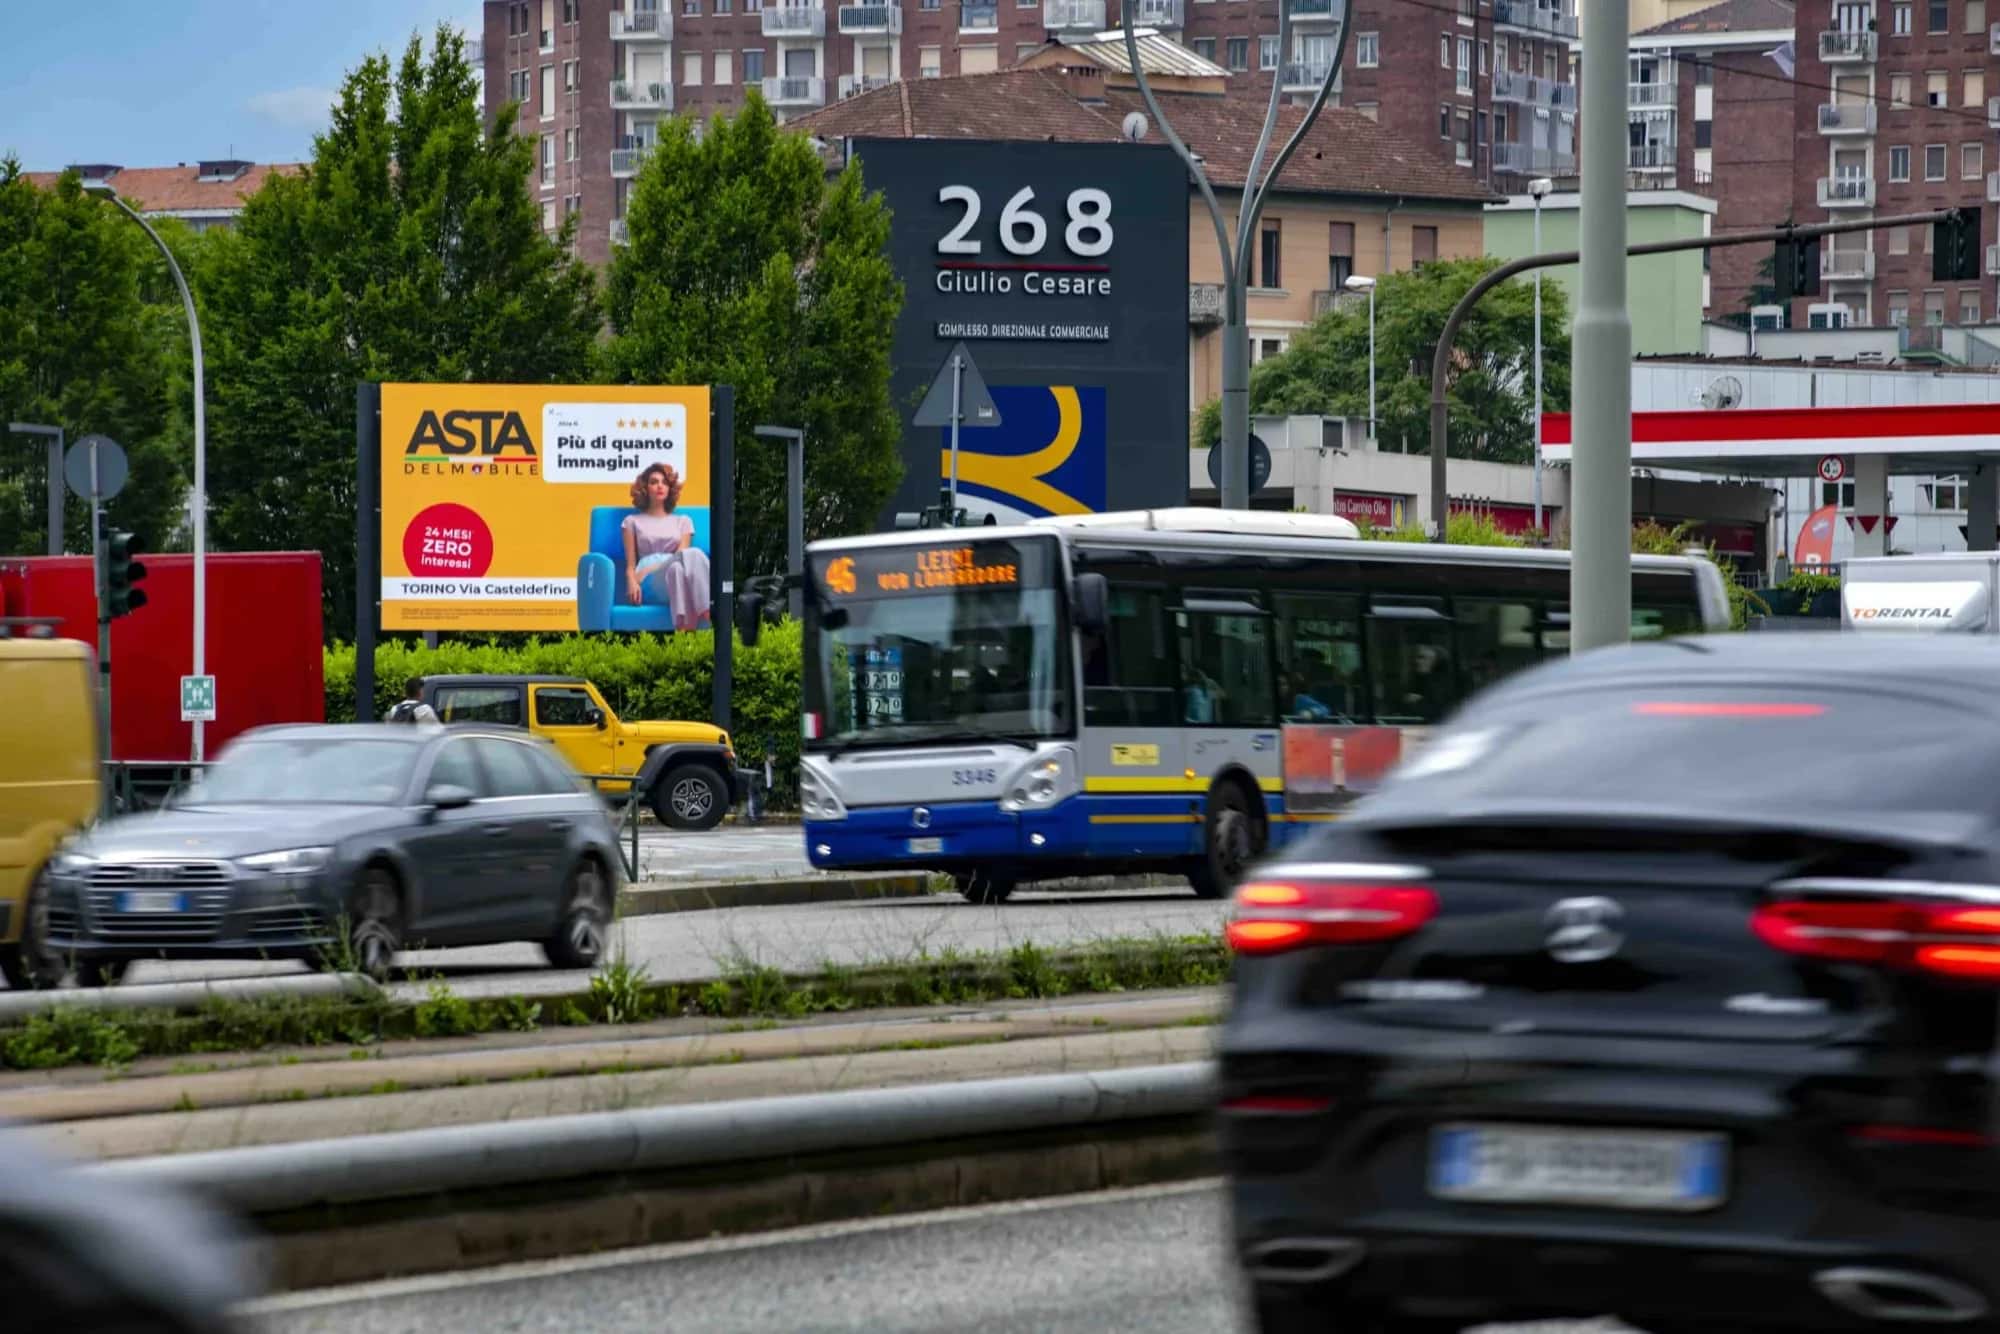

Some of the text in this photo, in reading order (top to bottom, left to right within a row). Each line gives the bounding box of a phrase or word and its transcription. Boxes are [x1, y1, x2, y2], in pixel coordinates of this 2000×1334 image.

[937, 185, 1114, 257] 268
[936, 270, 1112, 295] Giulio Cesare
[938, 323, 1109, 339] COMPLESSO DIREZIONALE COMMERCIALE
[405, 410, 537, 455] ASTA
[557, 435, 673, 453] Più di quanto
[557, 454, 640, 471] immagini
[425, 526, 473, 540] 24 MESI
[422, 539, 472, 556] ZERO
[421, 555, 472, 569] interessi
[402, 583, 571, 595] TORINO Via Casteldefino
[1852, 608, 1953, 619] TORENTAL
